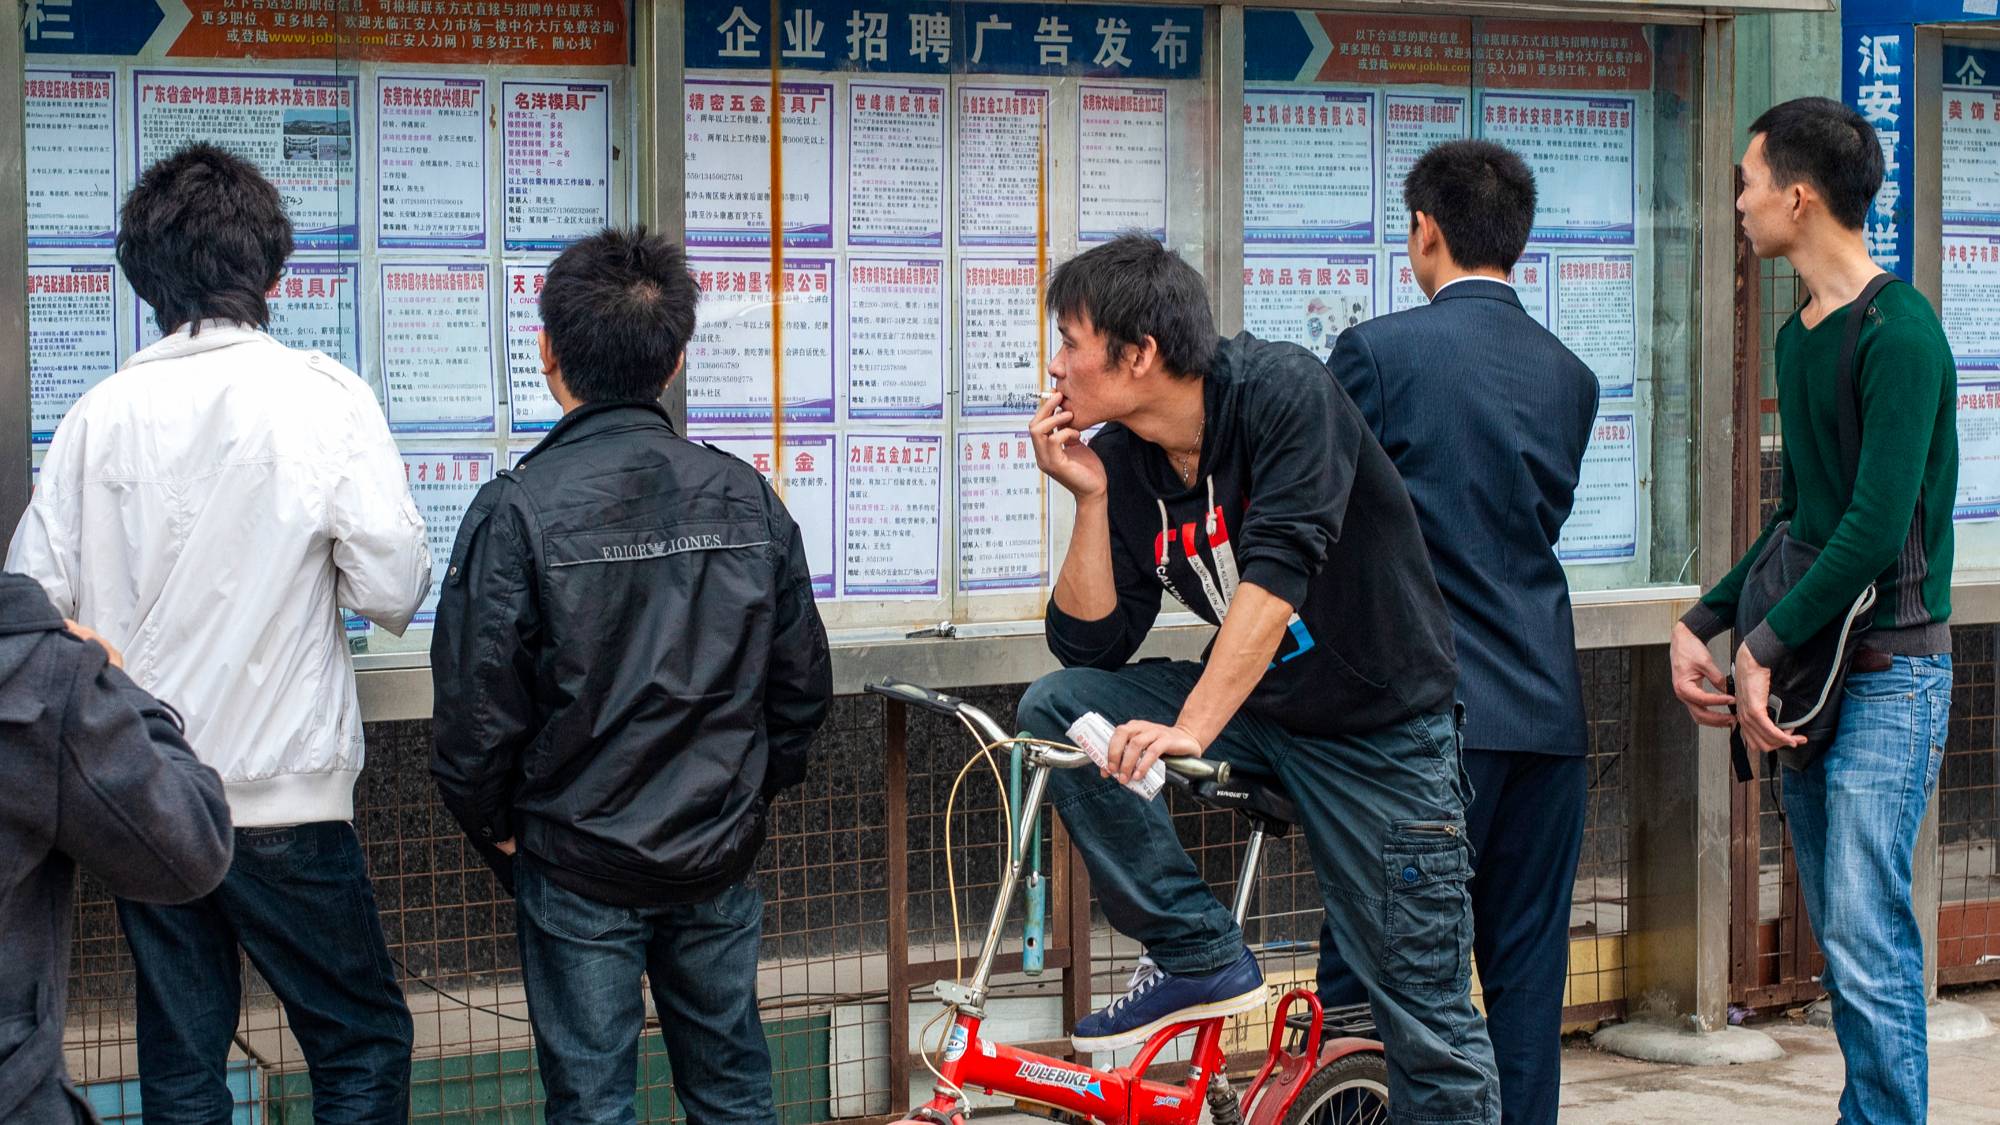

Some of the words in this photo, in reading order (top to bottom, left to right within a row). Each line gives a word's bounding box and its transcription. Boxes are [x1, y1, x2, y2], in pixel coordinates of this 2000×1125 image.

[717, 7, 1190, 67] 企业招聘广告发布
[142, 84, 351, 107] 广东省金叶烟草薄片技术开发有限公司
[383, 86, 481, 108] 东莞市长安欣兴模具厂
[515, 91, 597, 111] 名洋模具厂
[1957, 393, 2000, 411] 产经纪有限
[603, 543, 648, 559] EDIOR
[668, 534, 723, 552] JONES
[1018, 1060, 1092, 1087] LULEBIKE
